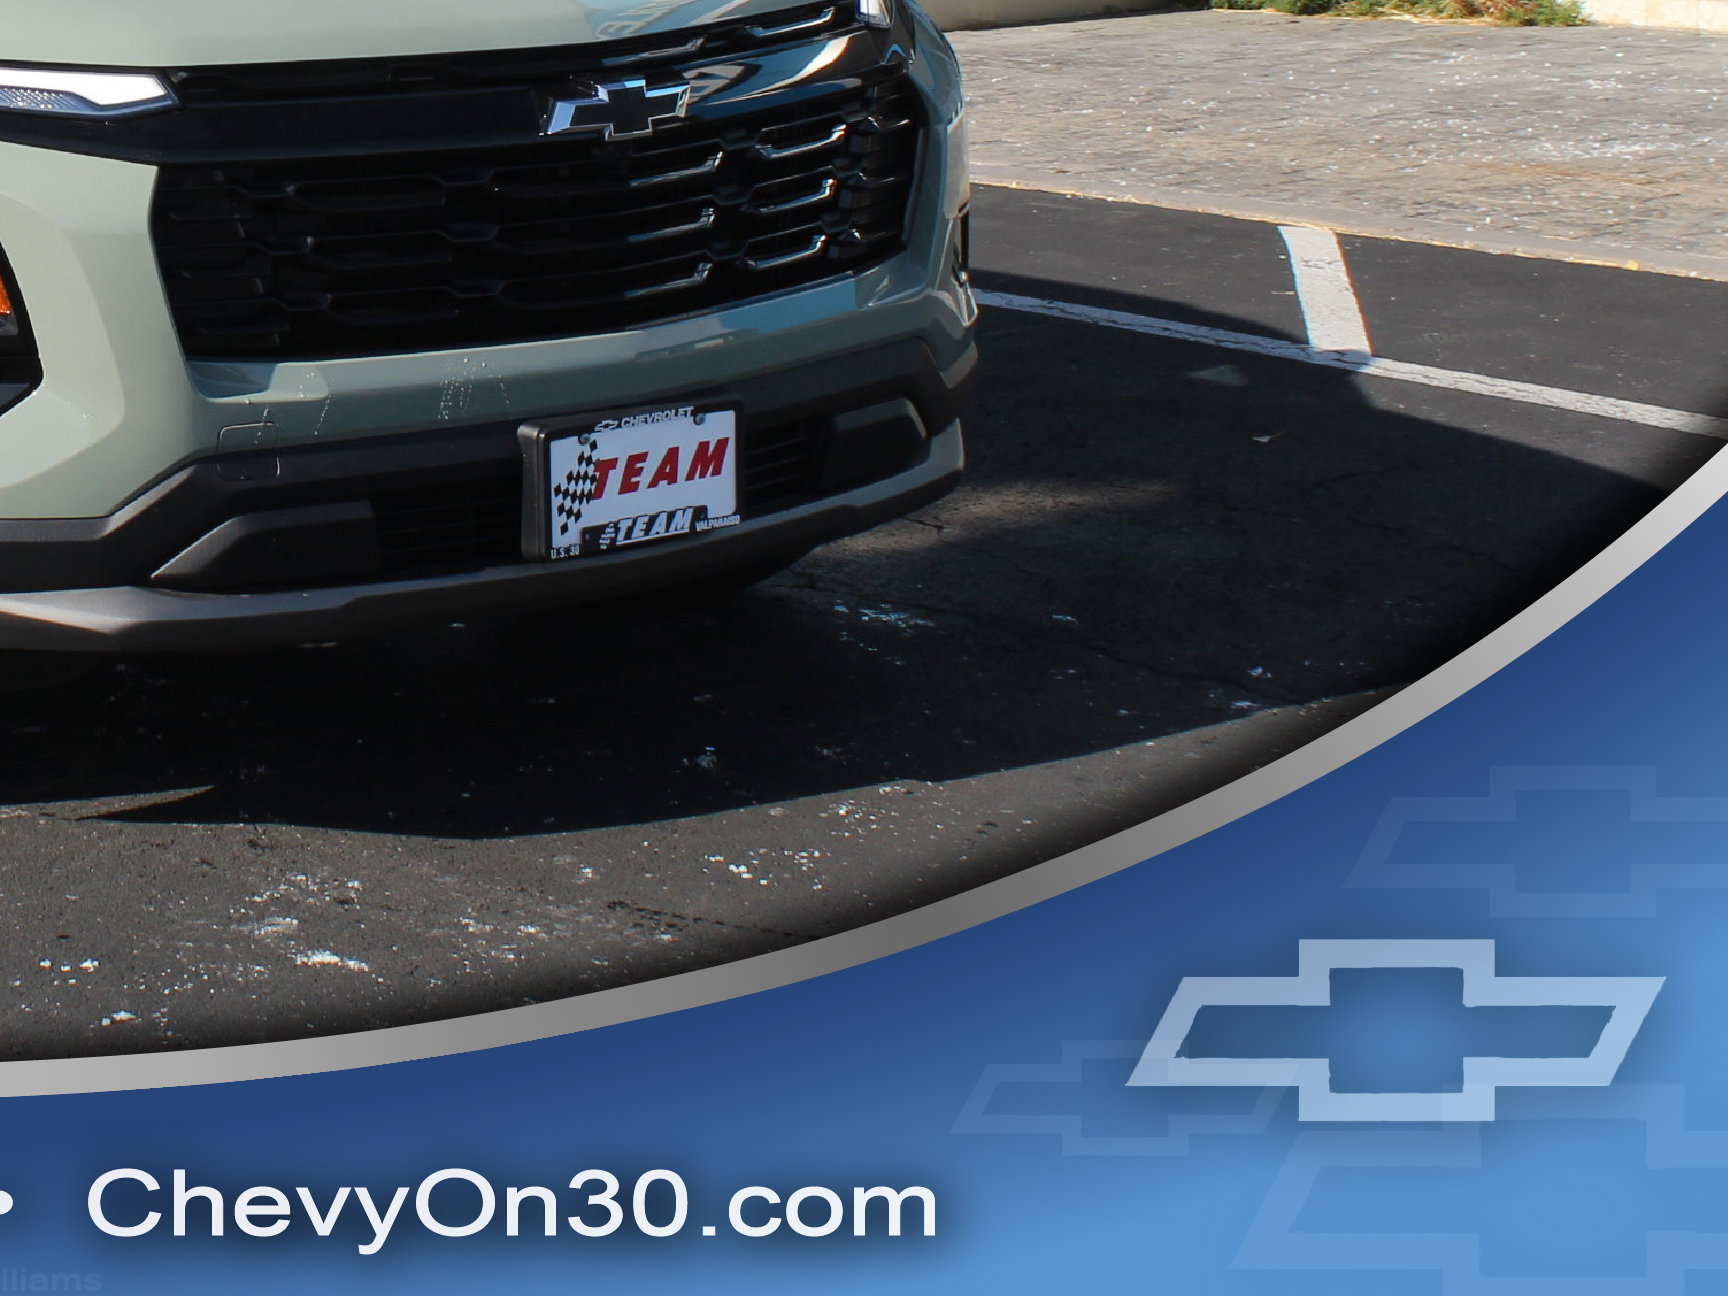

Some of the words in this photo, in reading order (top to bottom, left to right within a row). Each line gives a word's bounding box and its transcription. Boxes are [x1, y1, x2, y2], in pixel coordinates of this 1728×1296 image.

[620, 405, 695, 429] CHEVROLET
[591, 436, 730, 501] TEAM
[614, 507, 694, 546] TEAM
